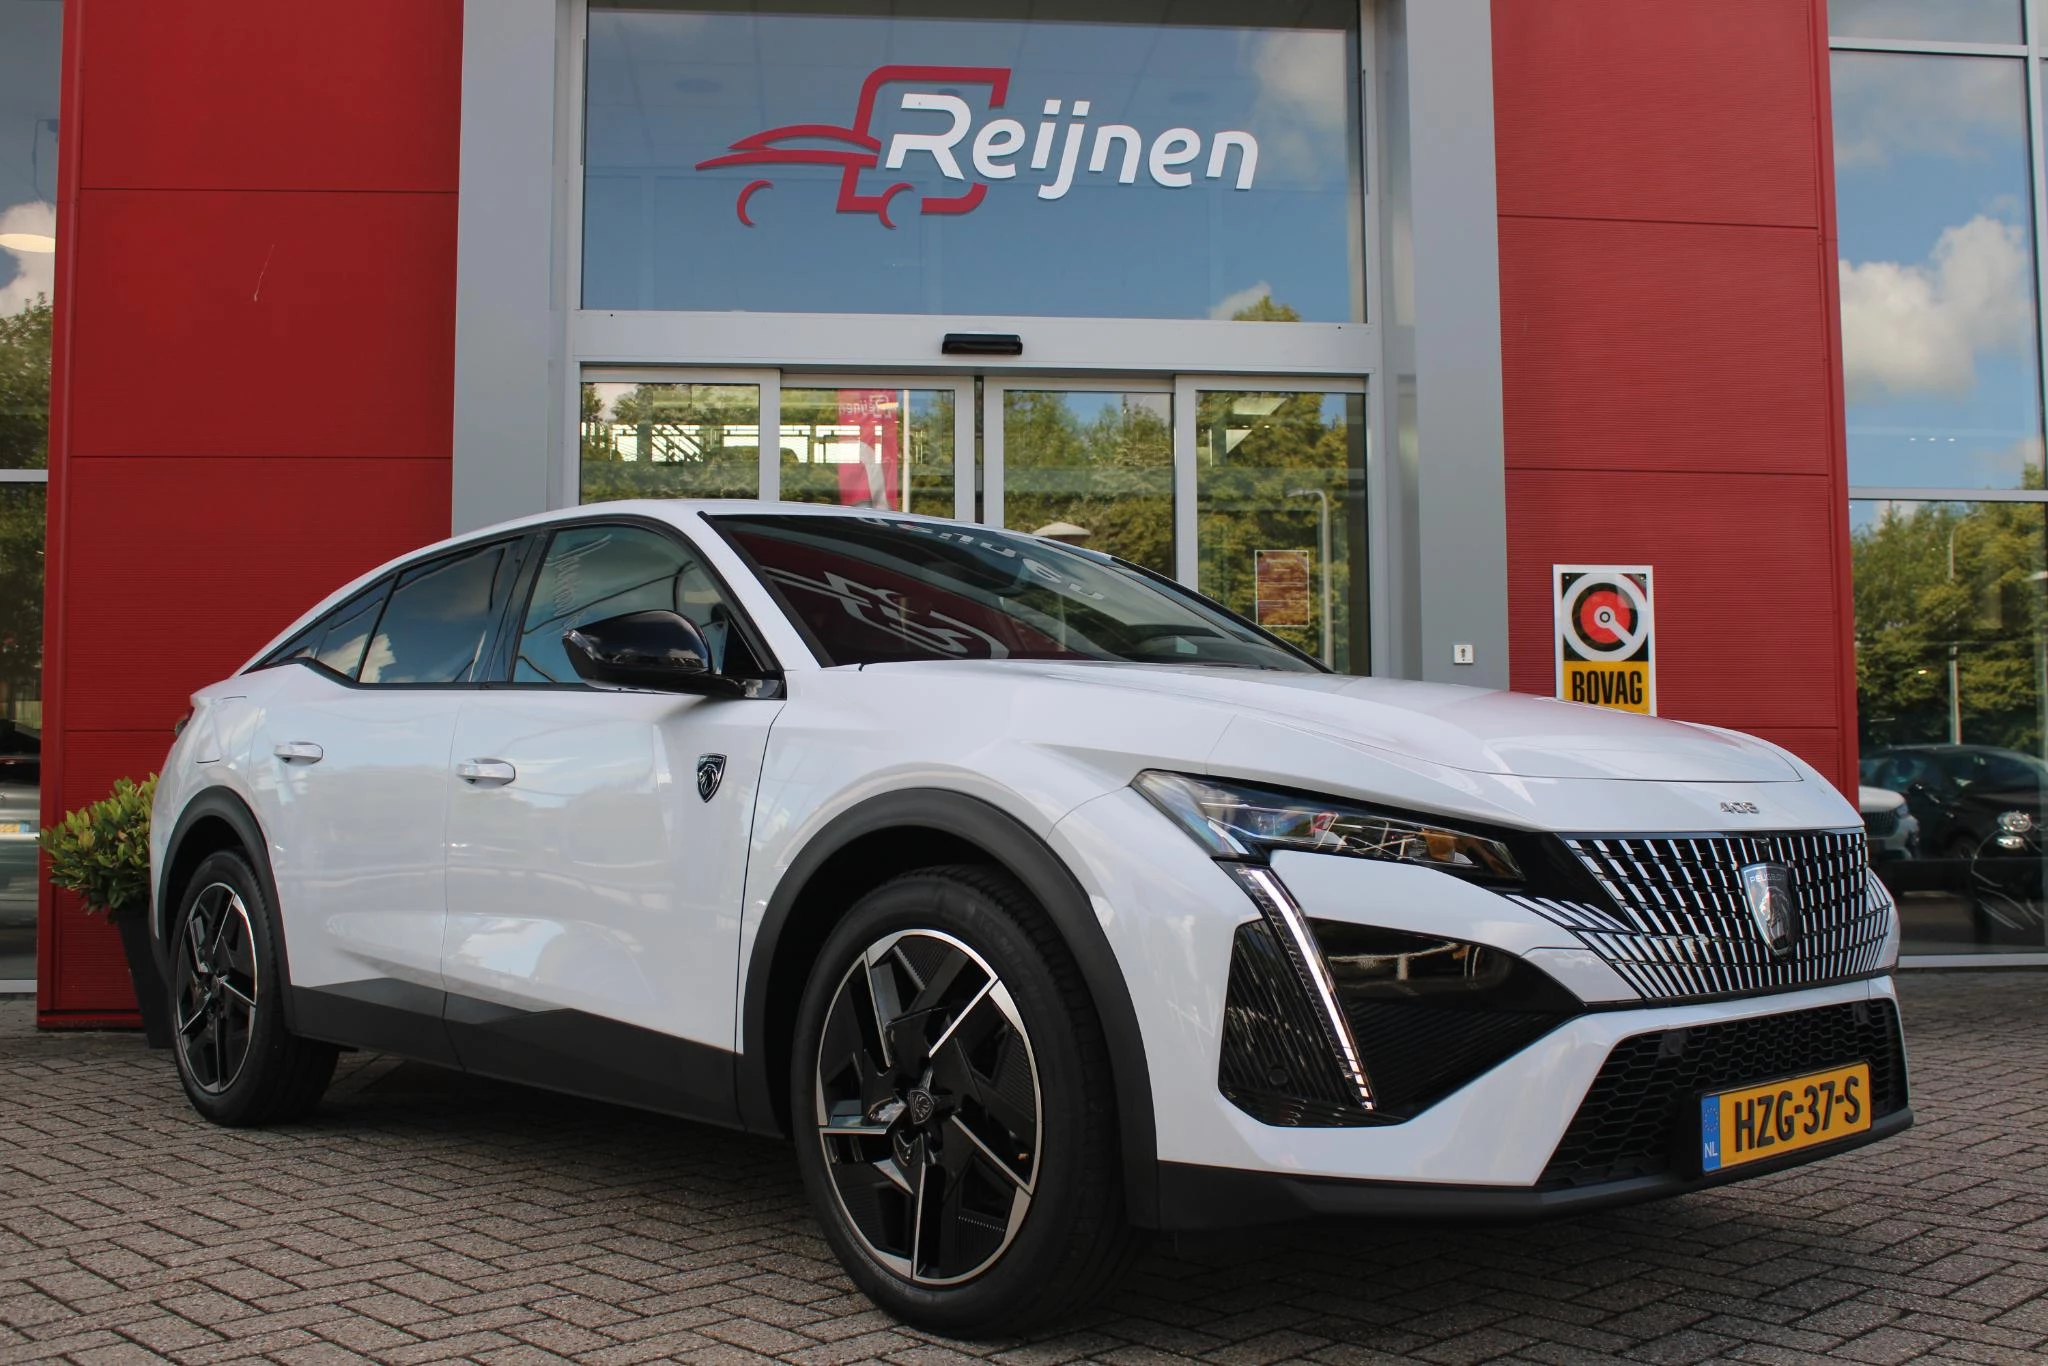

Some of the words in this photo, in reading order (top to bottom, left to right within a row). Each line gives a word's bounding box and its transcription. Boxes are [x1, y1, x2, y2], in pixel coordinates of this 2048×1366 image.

[885, 93, 1259, 200] Reijnen
[1571, 670, 1643, 705] BOVAG
[1720, 801, 1760, 815] 408
[1735, 1075, 1861, 1153] HZG-37-S
[1704, 1141, 1719, 1159] NL
